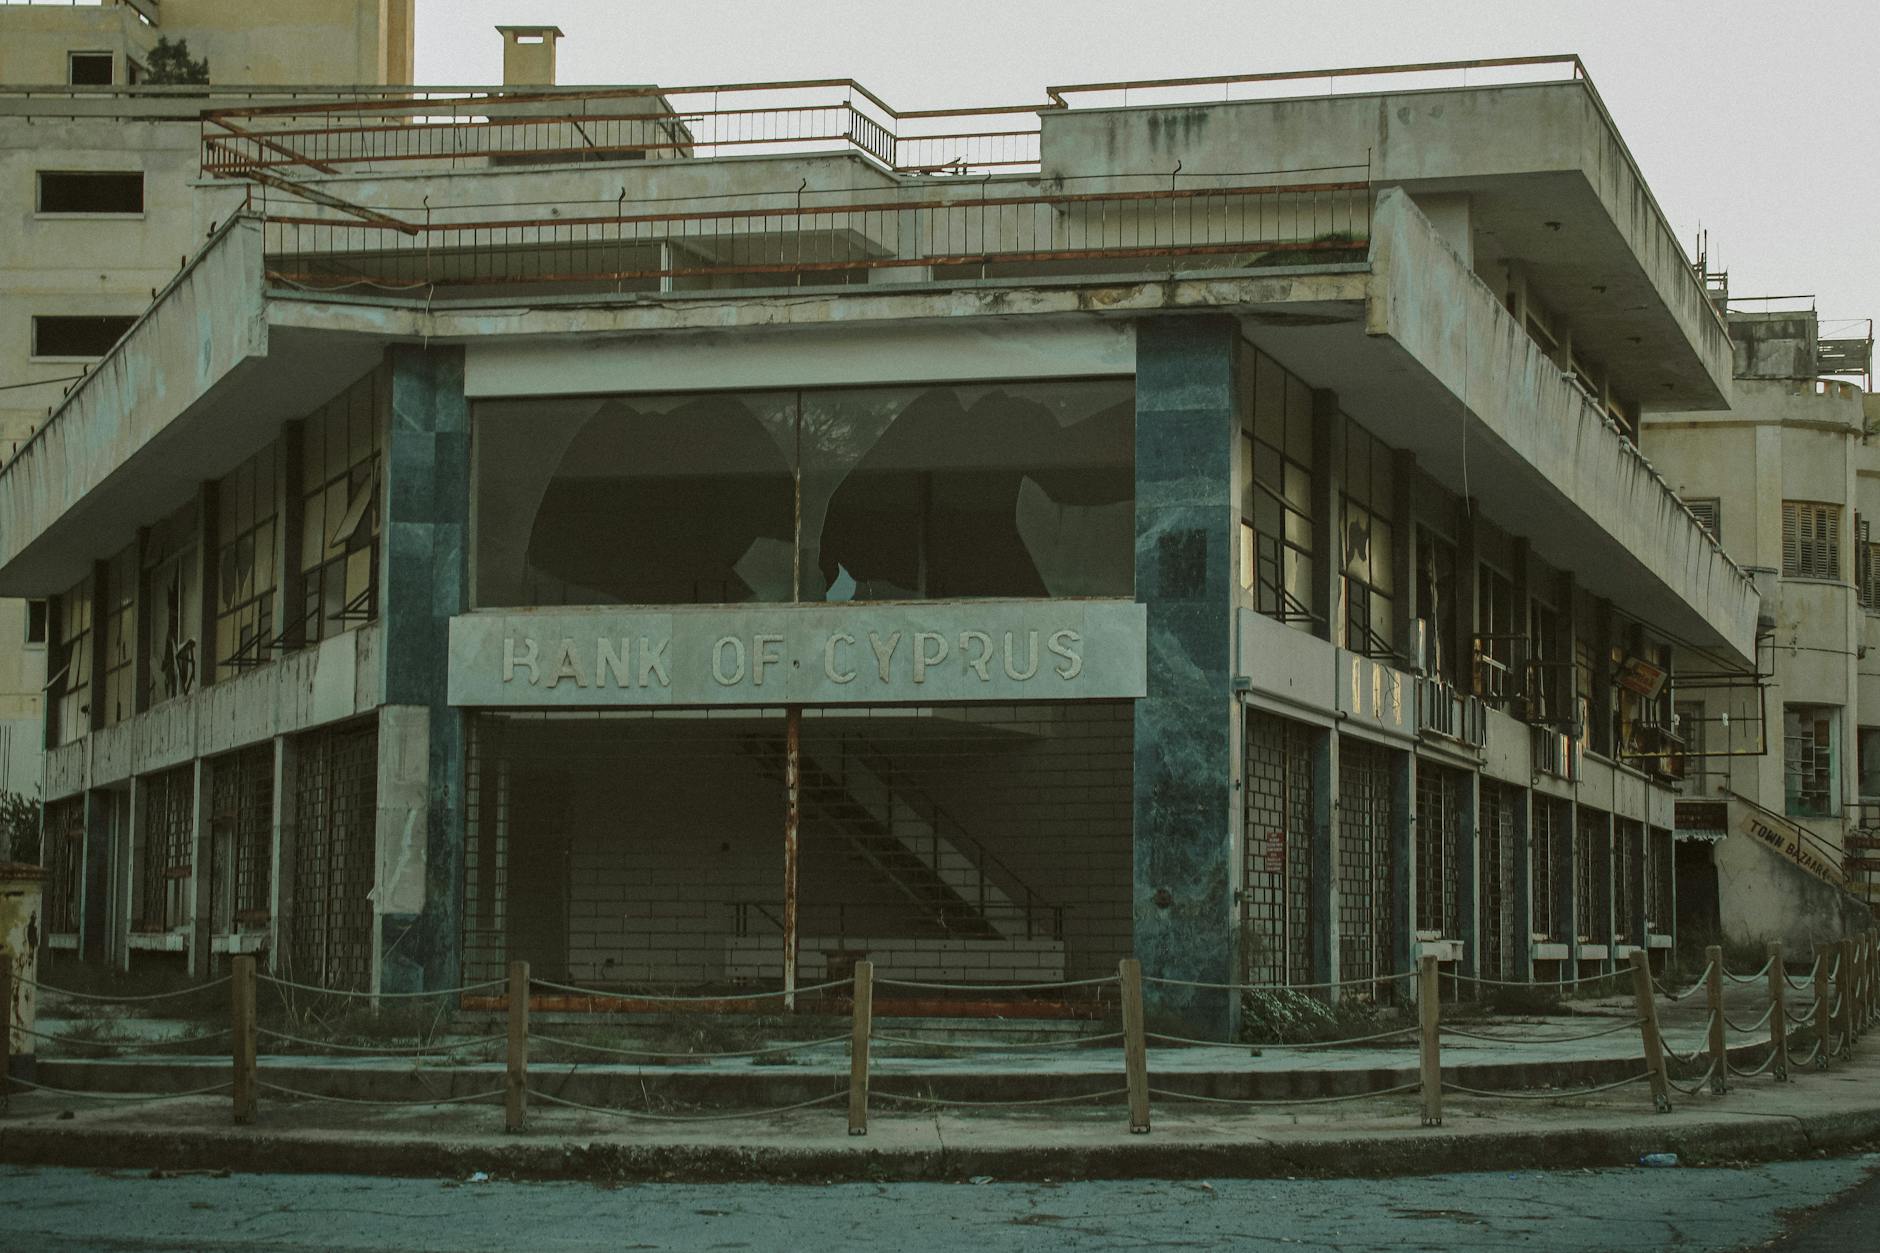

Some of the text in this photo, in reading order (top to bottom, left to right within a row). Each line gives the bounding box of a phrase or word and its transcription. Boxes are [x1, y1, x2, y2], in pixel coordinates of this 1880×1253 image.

[503, 630, 1084, 688] BANK OF CYPRUS
[1750, 819, 1785, 847] TOWN
